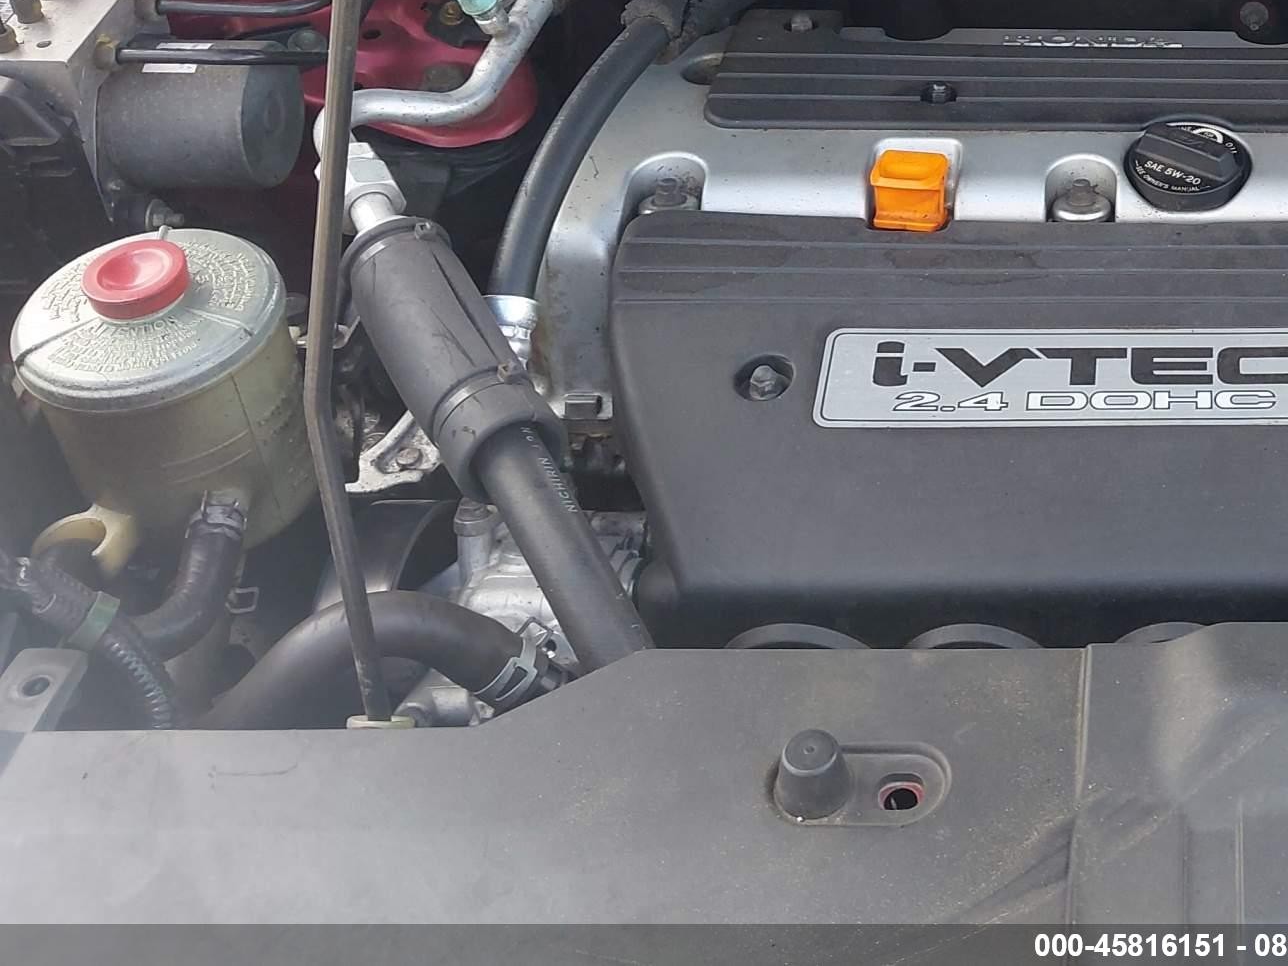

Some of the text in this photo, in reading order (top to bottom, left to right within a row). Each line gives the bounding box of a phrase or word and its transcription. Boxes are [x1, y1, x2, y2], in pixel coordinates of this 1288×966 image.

[1002, 33, 1183, 49] HONDA
[1143, 159, 1202, 186] SAE 5W-20
[1170, 185, 1201, 193] MANUAL
[891, 389, 1278, 413] 2.4 DOHC
[537, 456, 579, 513] NICHIRIN
